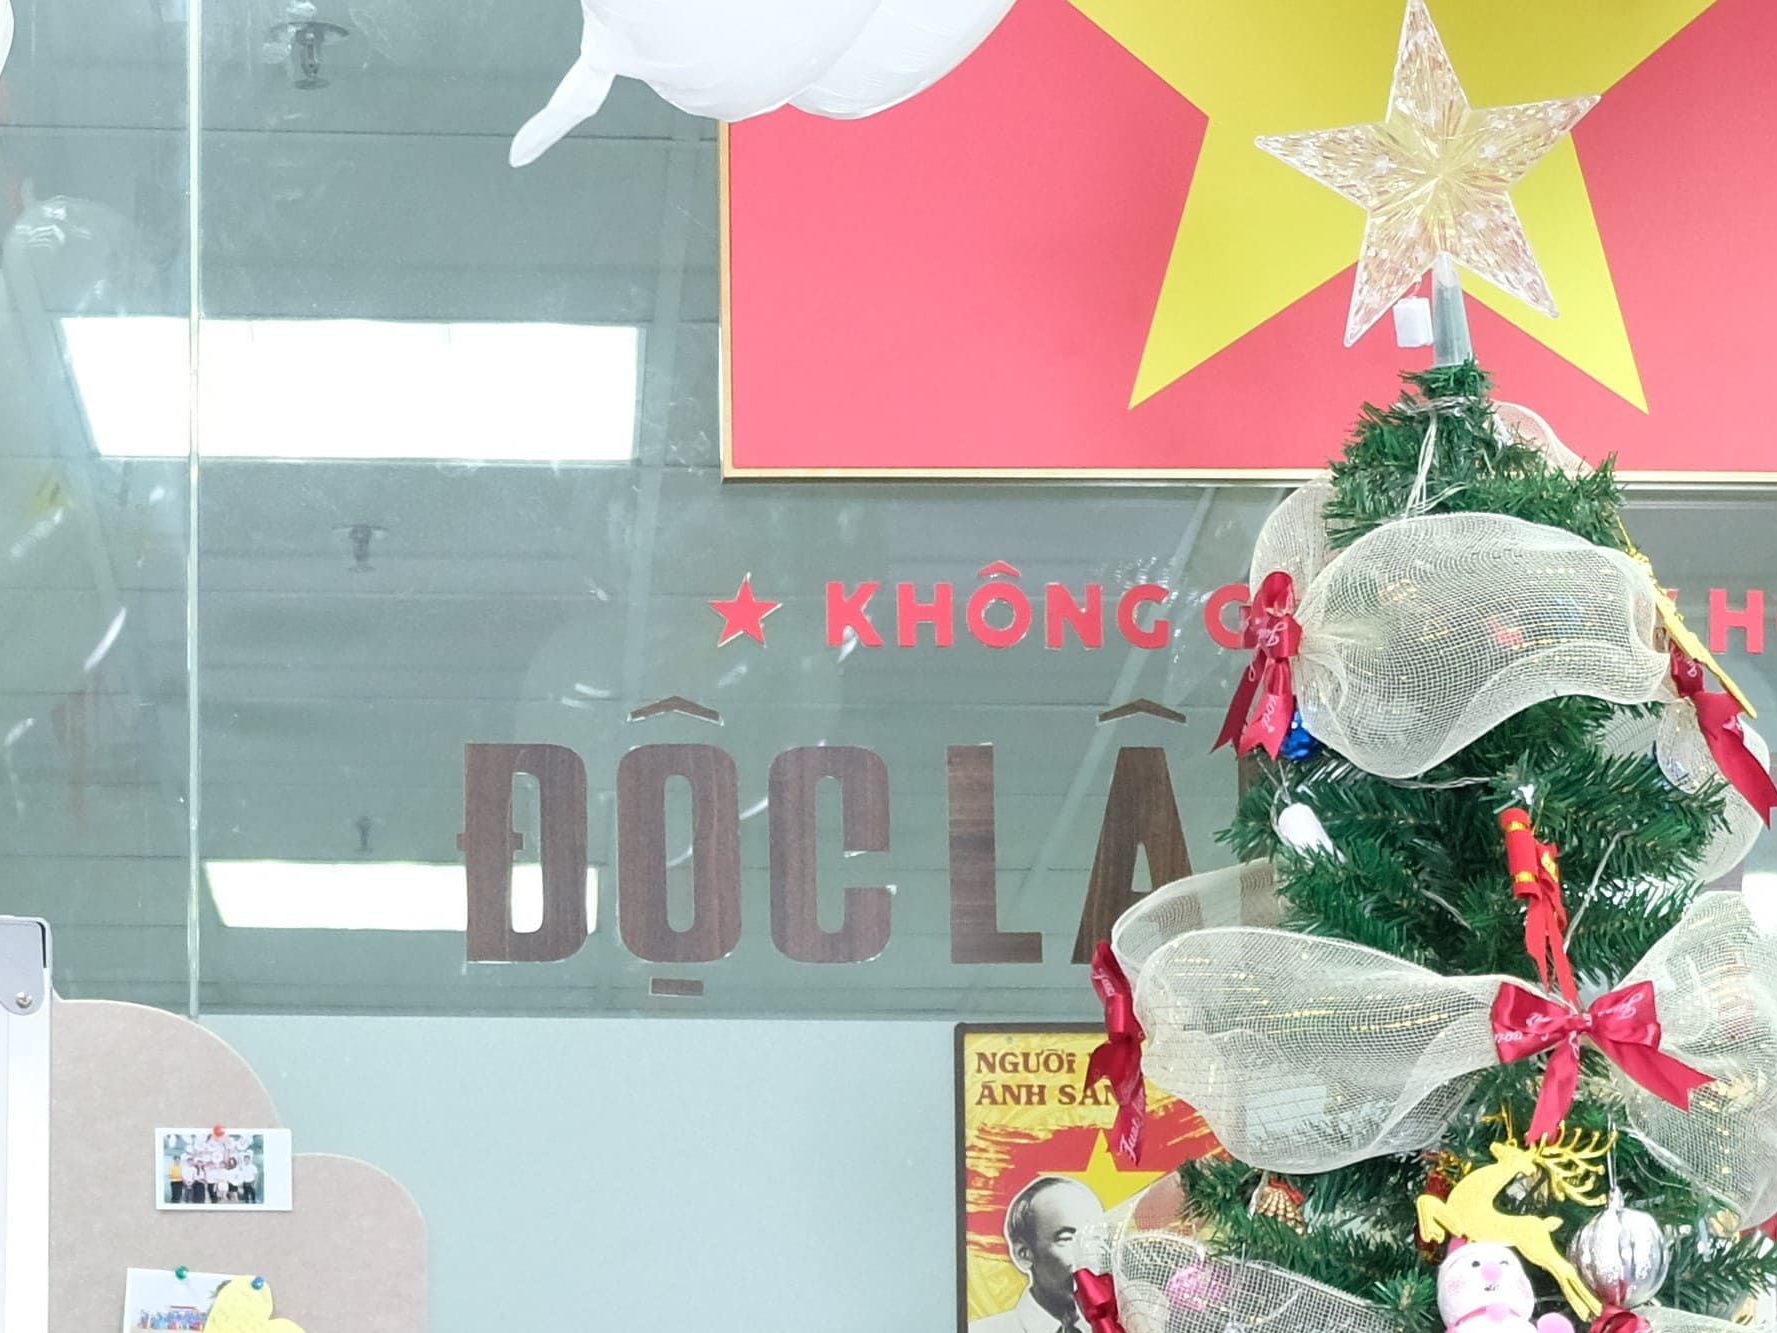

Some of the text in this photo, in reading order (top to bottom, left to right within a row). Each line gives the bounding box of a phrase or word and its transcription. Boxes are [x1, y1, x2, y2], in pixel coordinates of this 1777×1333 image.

[825, 560, 1171, 650] KHÔNG
[457, 696, 896, 997] ĐỘC
[975, 1080, 1045, 1106] ÁNH
